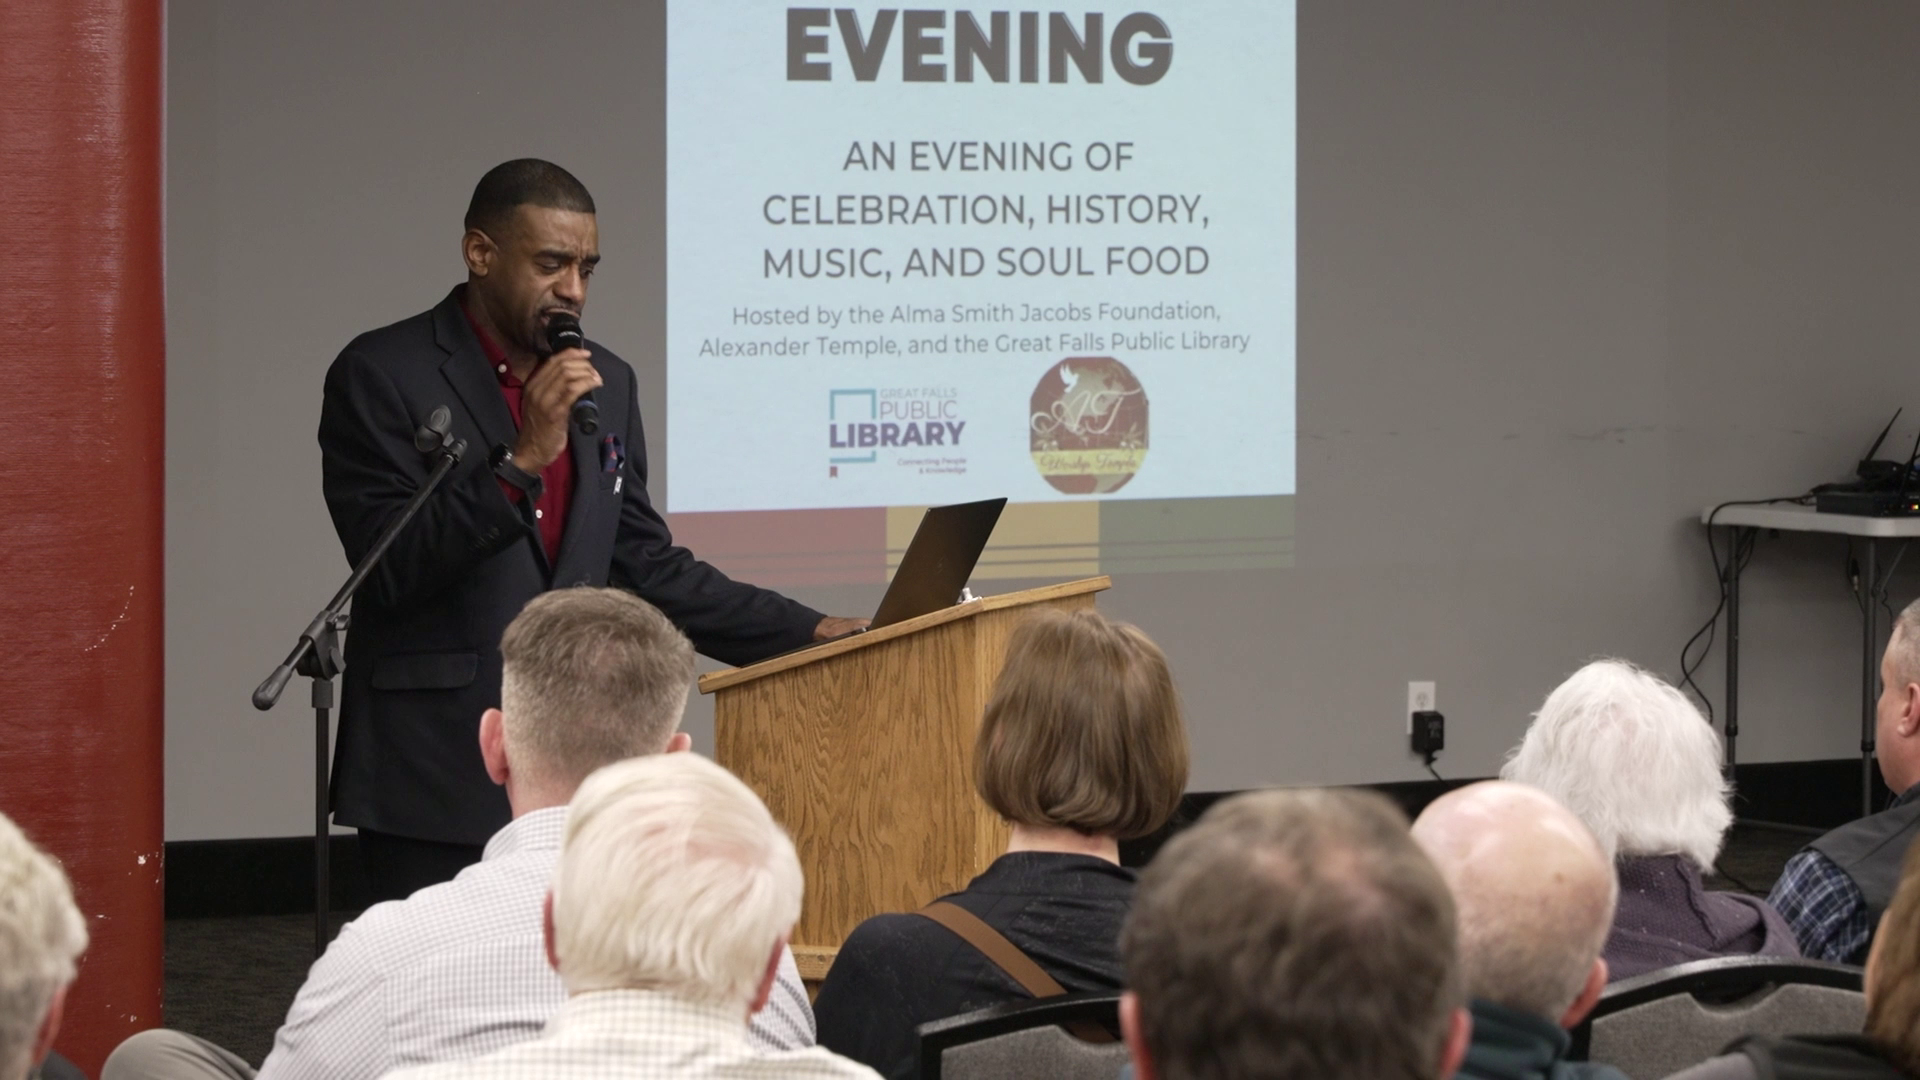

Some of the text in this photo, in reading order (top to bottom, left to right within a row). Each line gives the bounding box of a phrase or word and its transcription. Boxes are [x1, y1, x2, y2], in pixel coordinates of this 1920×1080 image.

[786, 8, 1174, 86] EVENING
[843, 142, 1134, 171] AN EVENING OF
[763, 194, 1210, 230] CELEBRATION, HISTORY,
[764, 246, 1210, 283] MUSIC, AND SOUL FOOD
[733, 301, 1221, 330] Hosted by the Alma Smith Jacobs Foundation,
[699, 331, 1251, 358] Alexander Temple, and the Great Falls Public Library
[880, 388, 957, 399] GREAT FALLS
[880, 400, 958, 420] PUBLIC
[829, 421, 966, 448] LIBRARY
